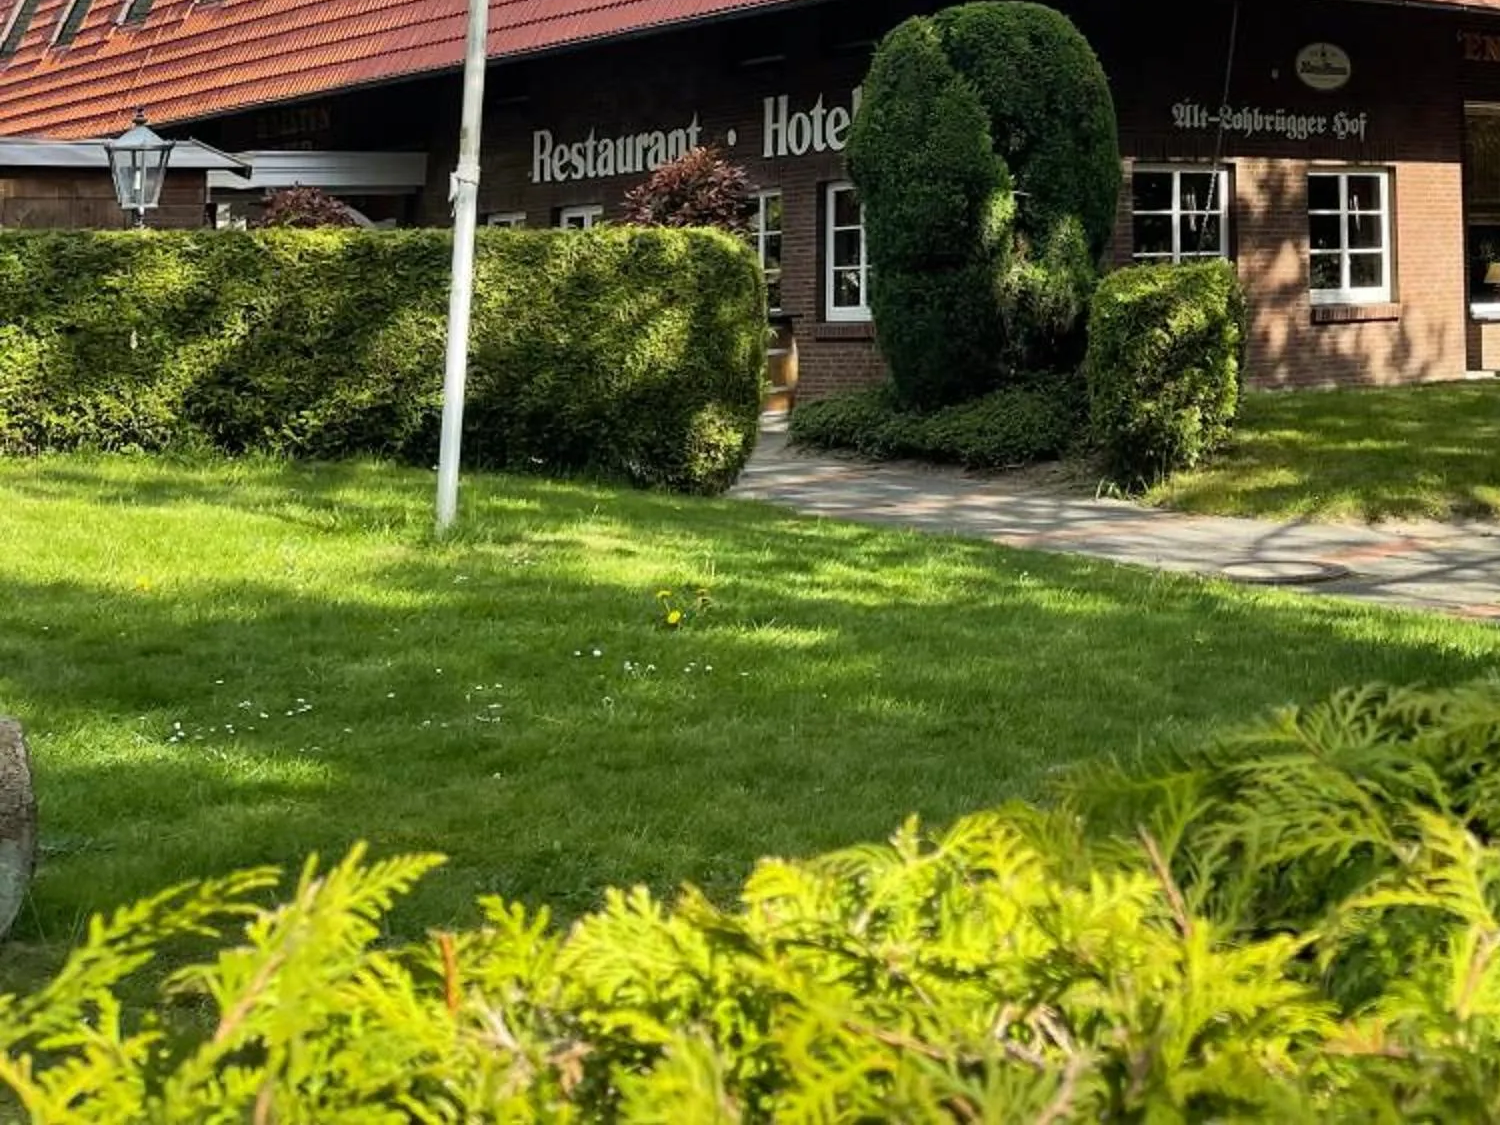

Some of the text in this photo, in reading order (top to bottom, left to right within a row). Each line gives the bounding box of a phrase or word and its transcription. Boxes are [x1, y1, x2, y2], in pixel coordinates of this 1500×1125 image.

[531, 111, 702, 183] Restaurant
[1171, 97, 1368, 143] Alt-Lohbrügger Hof
